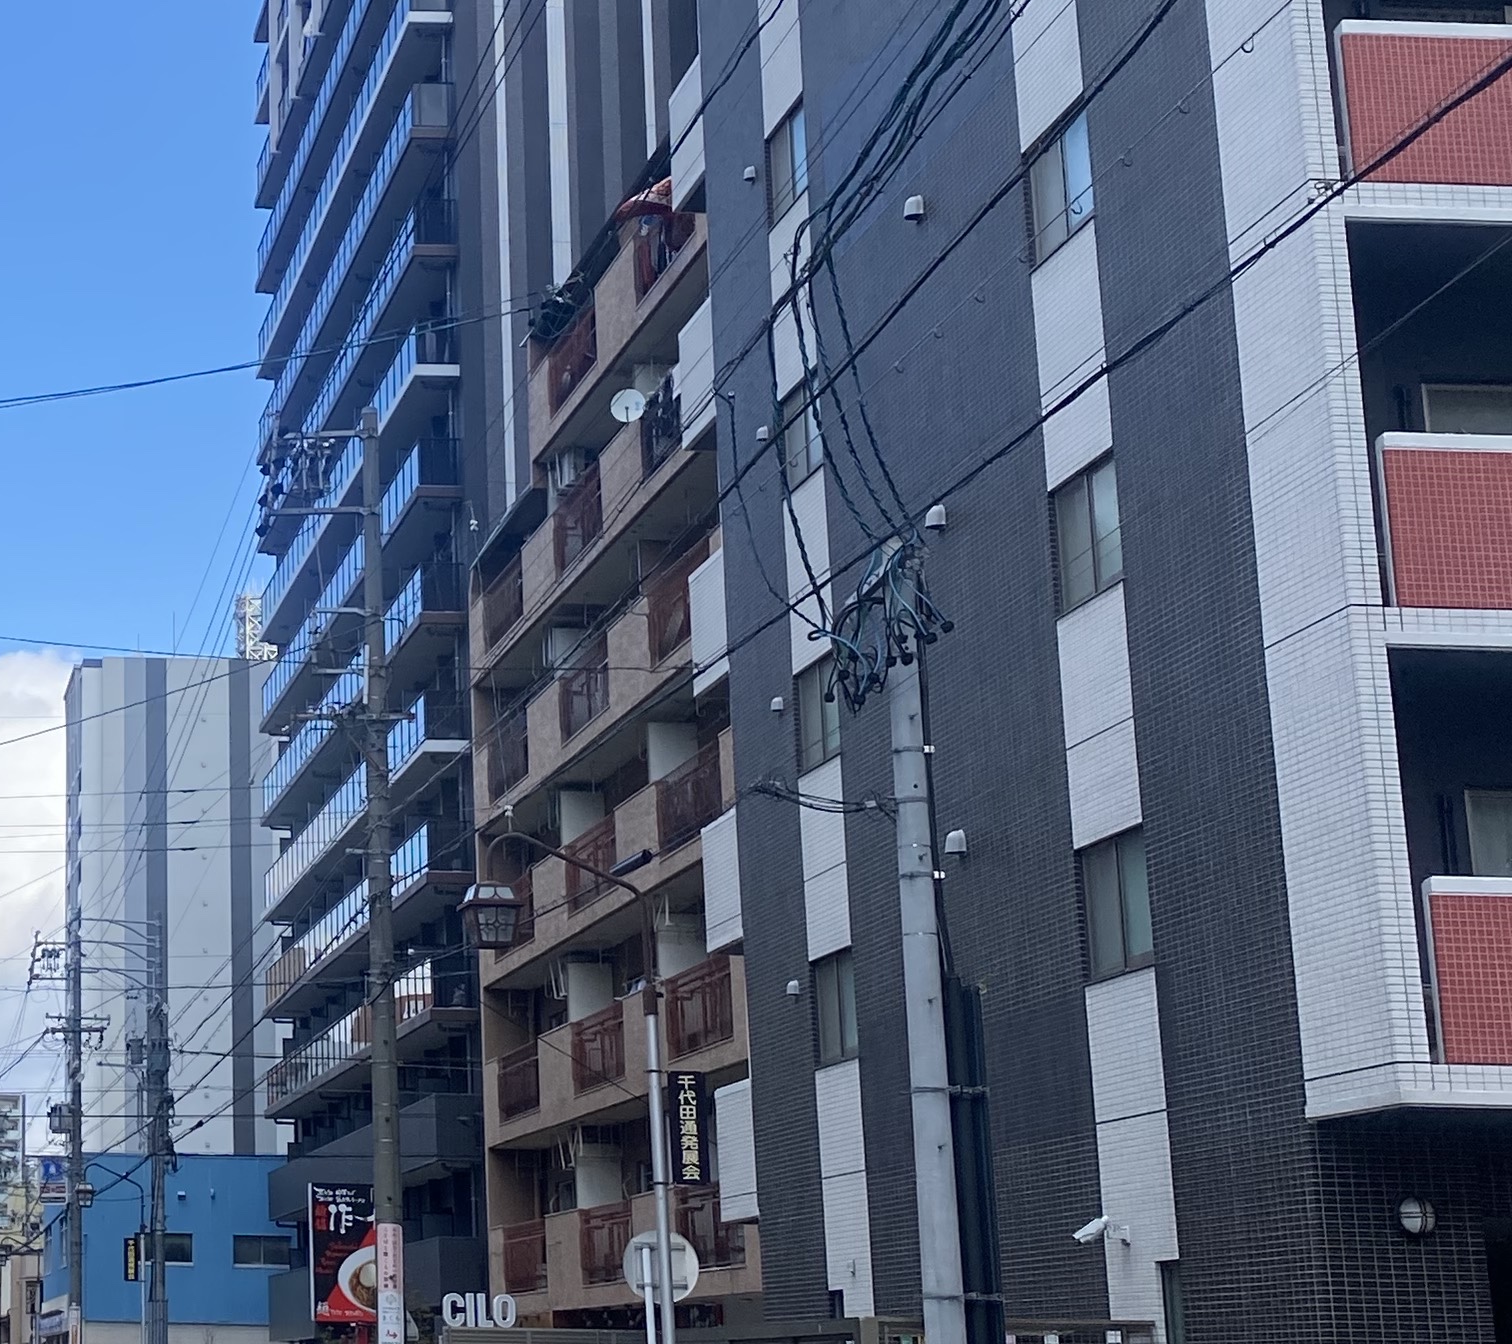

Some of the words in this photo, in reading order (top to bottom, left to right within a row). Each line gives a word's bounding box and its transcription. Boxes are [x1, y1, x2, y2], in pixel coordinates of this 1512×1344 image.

[677, 1074, 701, 1181] 千代田通発展会
[442, 1292, 516, 1329] CILO
